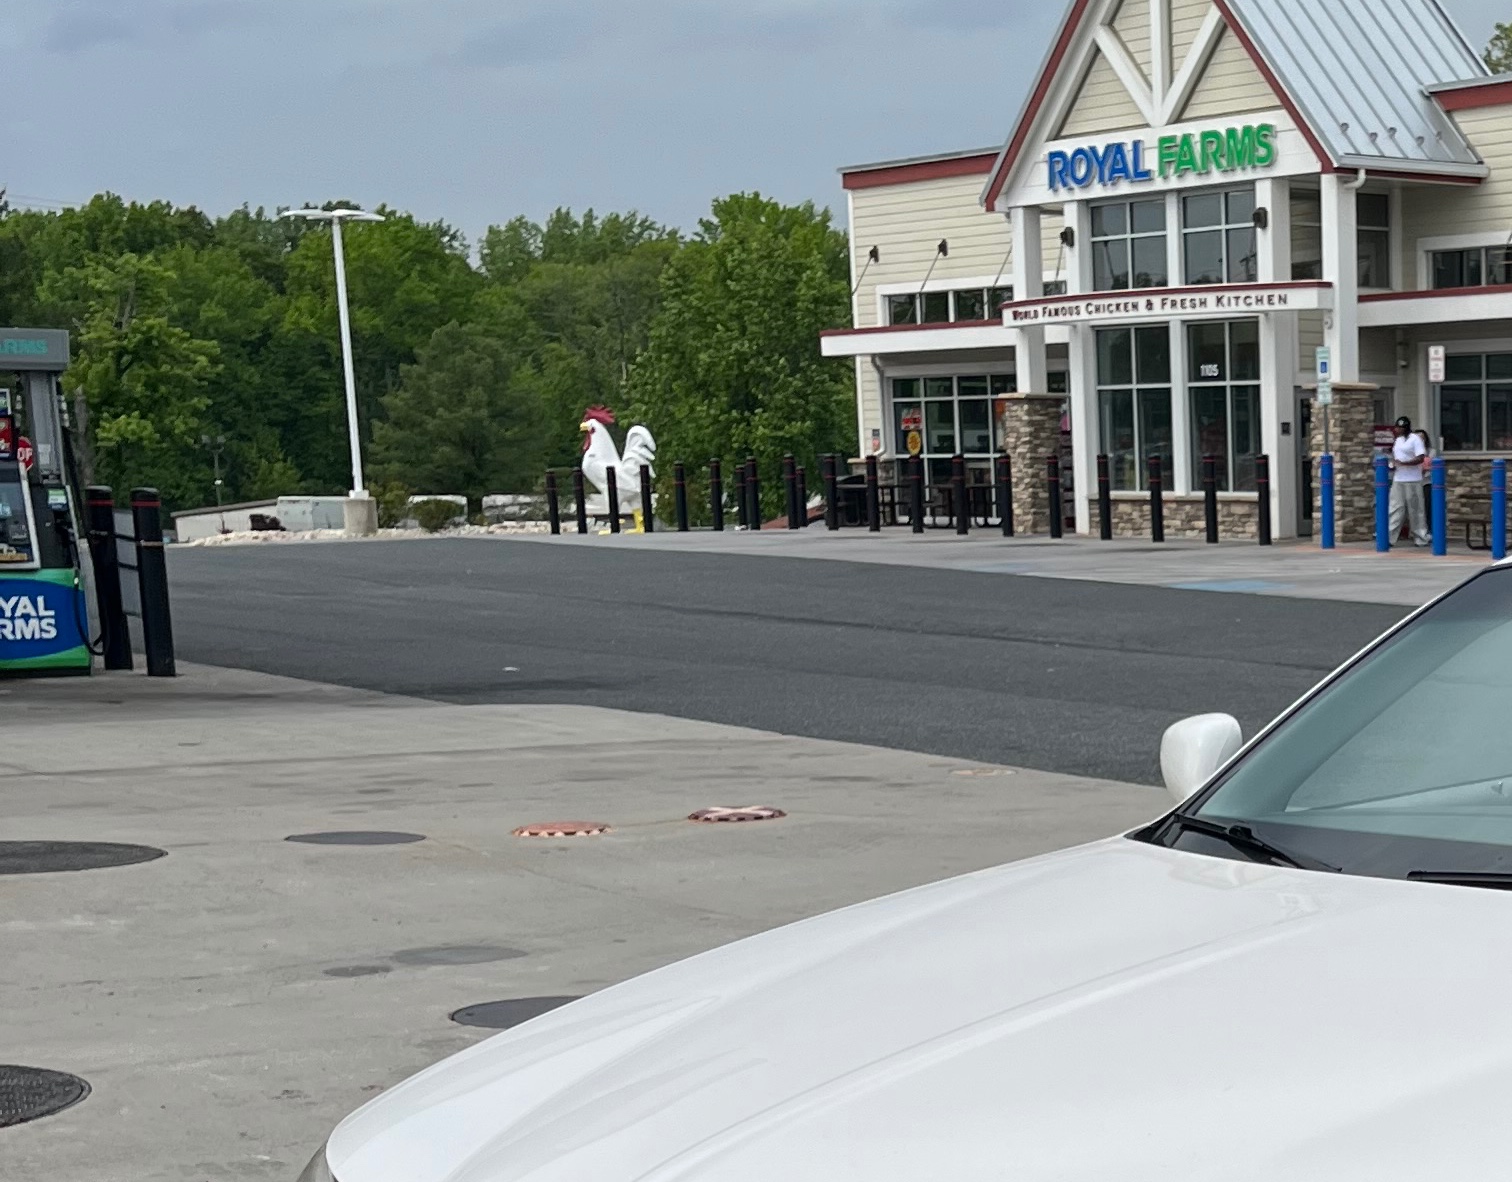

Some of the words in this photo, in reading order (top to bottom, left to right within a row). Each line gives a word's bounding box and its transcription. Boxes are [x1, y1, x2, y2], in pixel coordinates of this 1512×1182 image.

[1047, 139, 1151, 191] ROYAL
[1157, 123, 1276, 178] FARMS
[1085, 301, 1139, 315] CHICKEN
[1145, 299, 1154, 311] &
[1161, 297, 1208, 310] FRESH
[1216, 294, 1288, 308] KITCHEN
